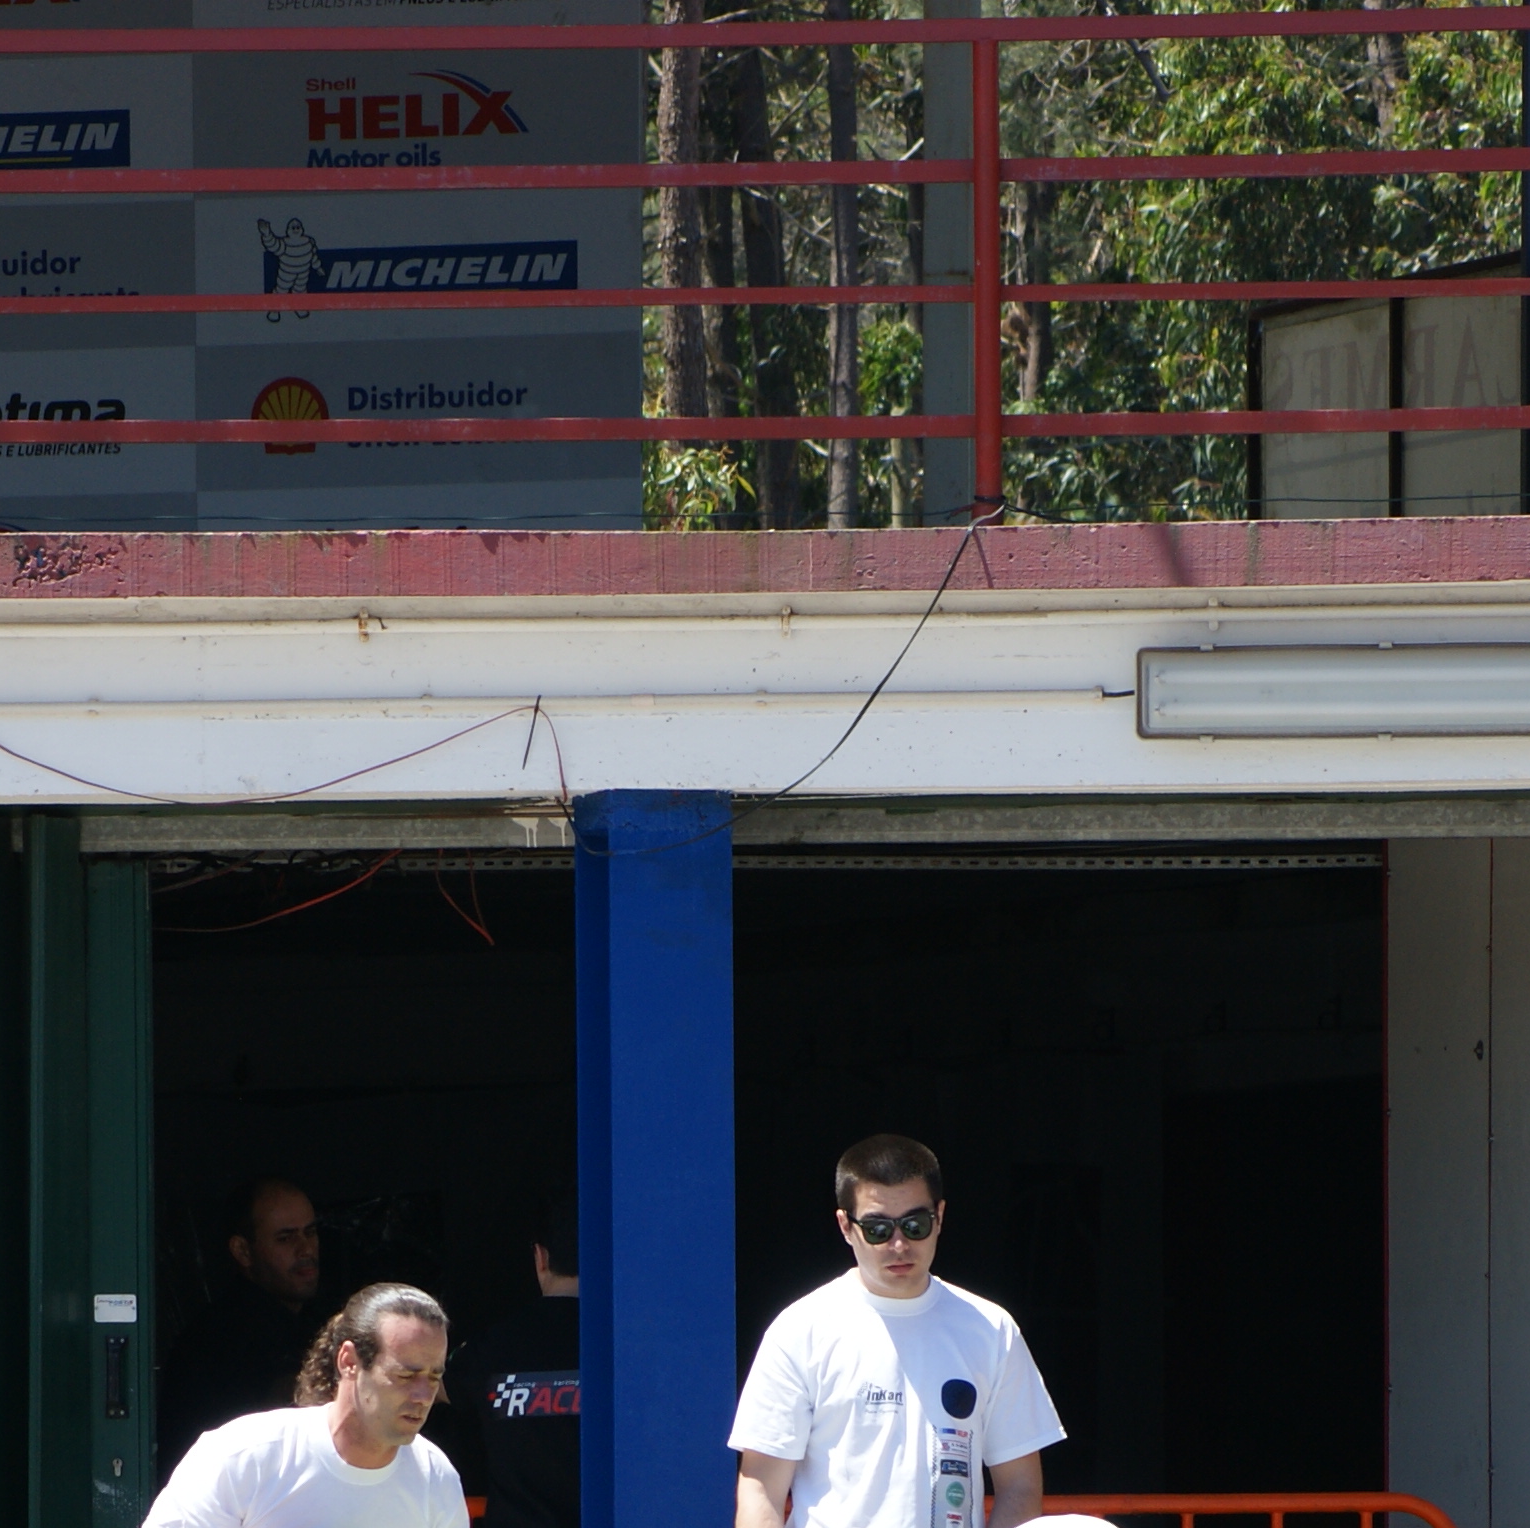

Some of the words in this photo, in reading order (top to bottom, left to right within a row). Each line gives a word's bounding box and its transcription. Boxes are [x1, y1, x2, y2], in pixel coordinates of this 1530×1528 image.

[305, 77, 357, 92] Shell
[305, 80, 525, 142] HELIX
[307, 147, 390, 168] Motor
[395, 142, 442, 168] oils
[325, 252, 568, 290] MICHELIN
[347, 380, 529, 412] Distribuidor
[5, 445, 15, 458] E
[16, 443, 122, 458] LUBRIFICANTES
